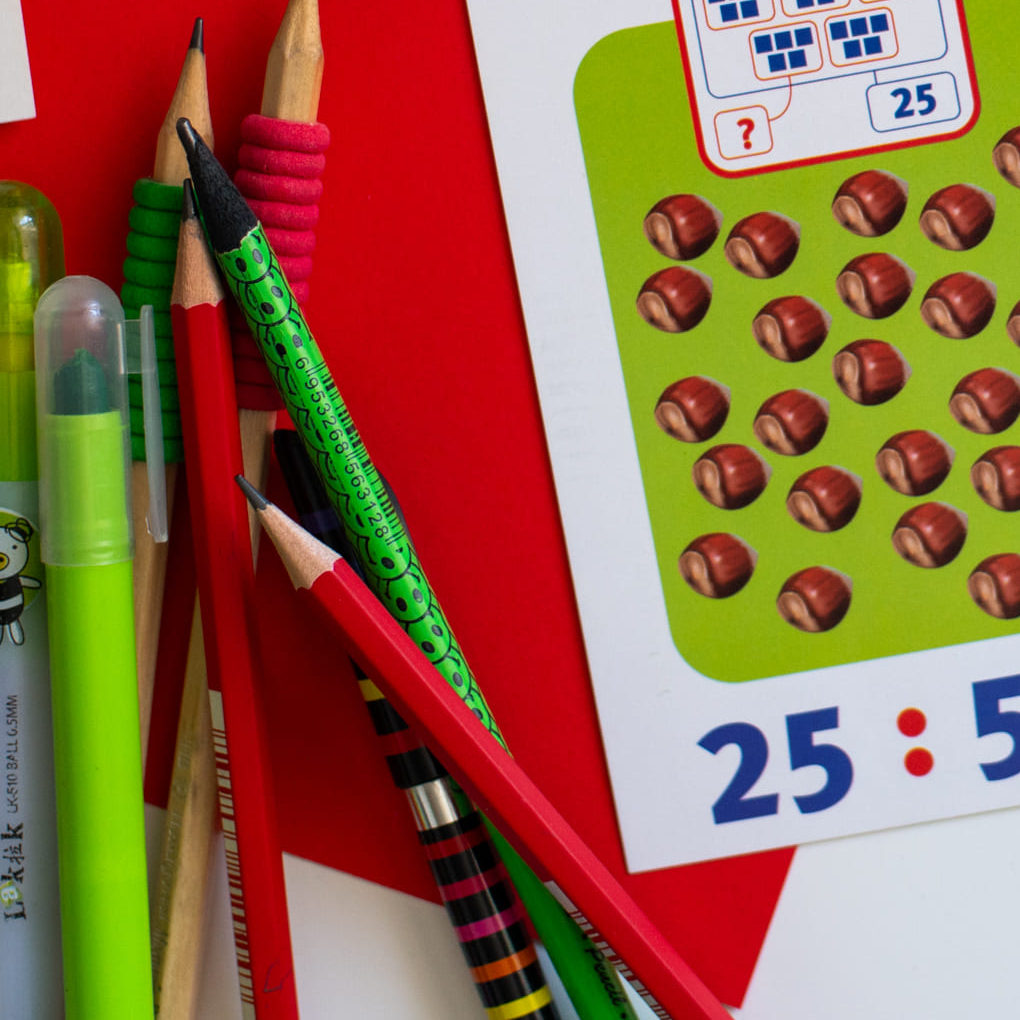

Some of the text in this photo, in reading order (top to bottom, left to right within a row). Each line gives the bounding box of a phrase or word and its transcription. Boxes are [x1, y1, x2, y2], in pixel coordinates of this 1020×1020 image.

[889, 82, 937, 120] 25
[736, 117, 755, 150] ?
[295, 357, 390, 539] 6 953268 563128
[6, 739, 19, 771] BALL
[696, 705, 855, 826] 25
